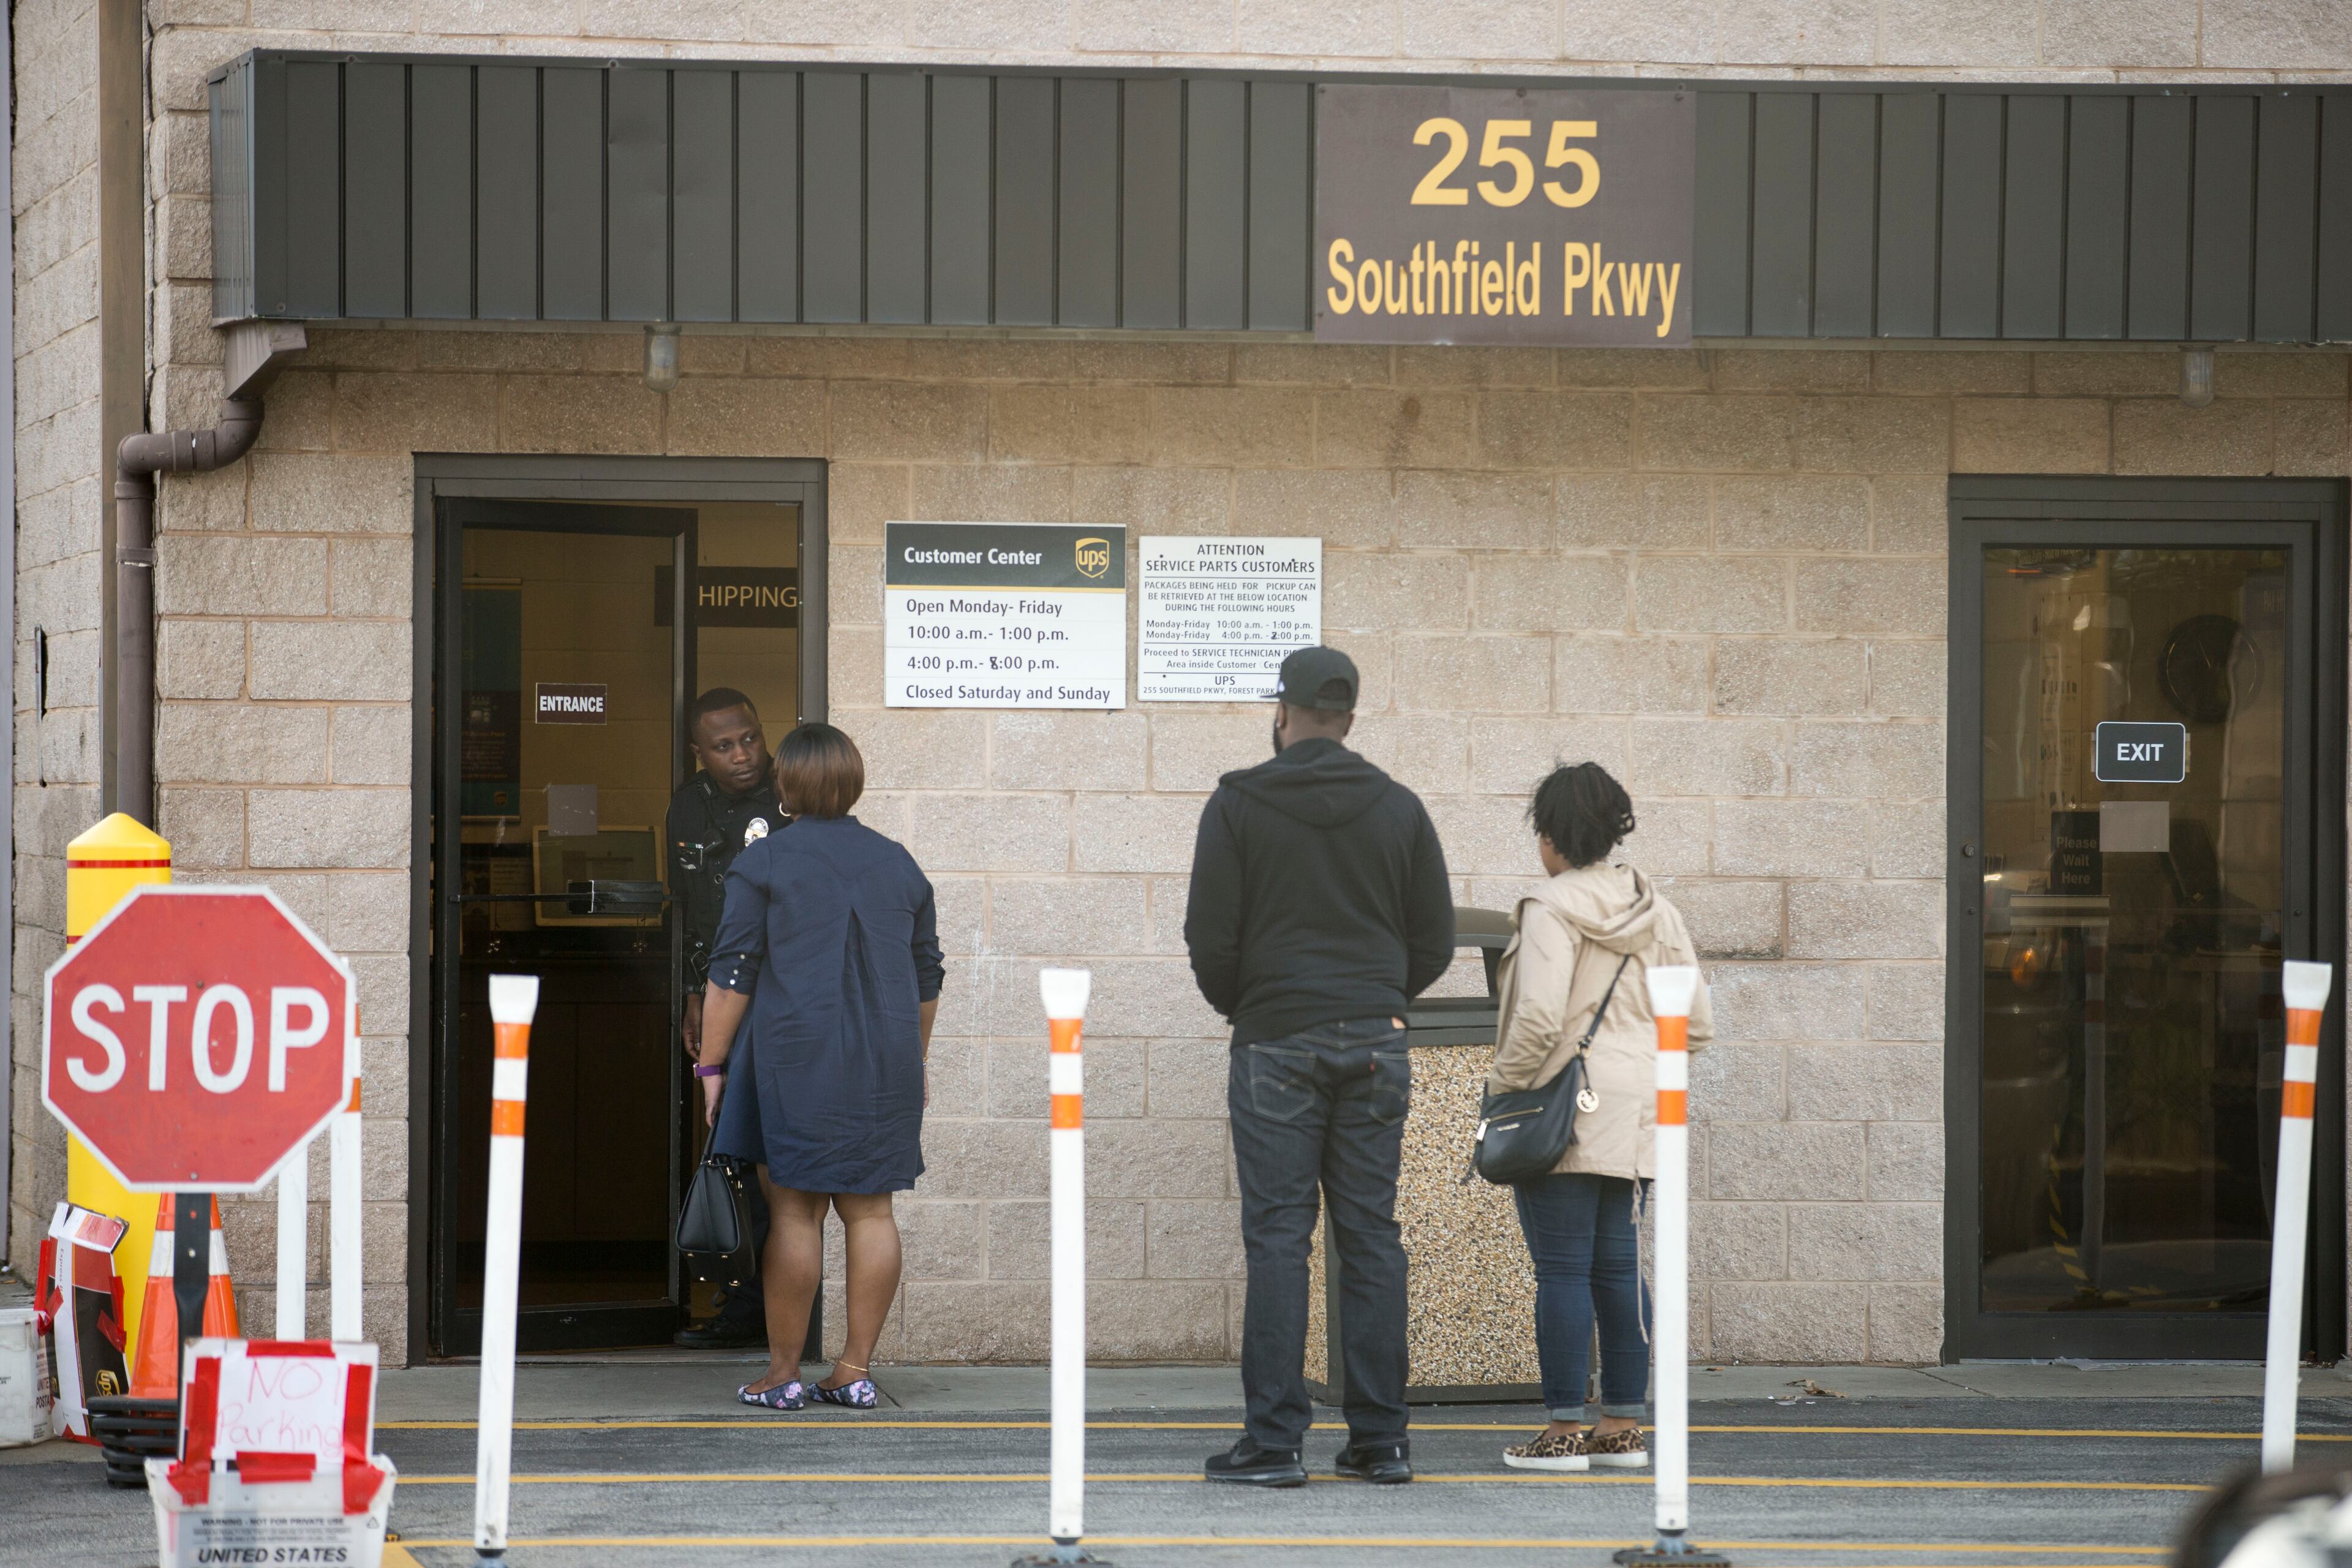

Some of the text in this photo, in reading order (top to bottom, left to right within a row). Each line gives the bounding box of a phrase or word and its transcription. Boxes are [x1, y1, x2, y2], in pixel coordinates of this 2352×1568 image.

[1411, 118, 1600, 208] 255
[1327, 238, 1681, 337] Southfield Pkwy
[905, 547, 1042, 565] Customer Center
[1197, 545, 1264, 555] ATTENTION
[1078, 550, 1106, 571] ups
[1147, 560, 1314, 572] SERVICE PARTS CUSTOMERS
[699, 586, 797, 608] HIPPING
[907, 599, 943, 616] Open
[1020, 600, 1062, 617] Friday
[1147, 620, 1210, 630] Monday-Friday
[909, 626, 950, 639] 10:00
[1000, 627, 1031, 639] 1:00
[1038, 631, 1068, 643] p.m.
[1147, 631, 1210, 640] Monday-Friday
[908, 657, 940, 669] 4:00
[1028, 660, 1058, 672] p.m.
[1215, 676, 1235, 685] UPS
[907, 685, 1110, 703] Closed Saturday and Sunday
[540, 696, 603, 712] ENTRANCE
[2117, 744, 2163, 761] EXIT
[2057, 837, 2097, 848] Please
[2064, 854, 2089, 866] Wait
[2062, 872, 2090, 884] Here
[66, 983, 330, 1094] STOP
[36, 1395, 50, 1409] POSTA
[217, 1402, 343, 1458] Parking
[198, 1548, 348, 1562] UNITED STATES
